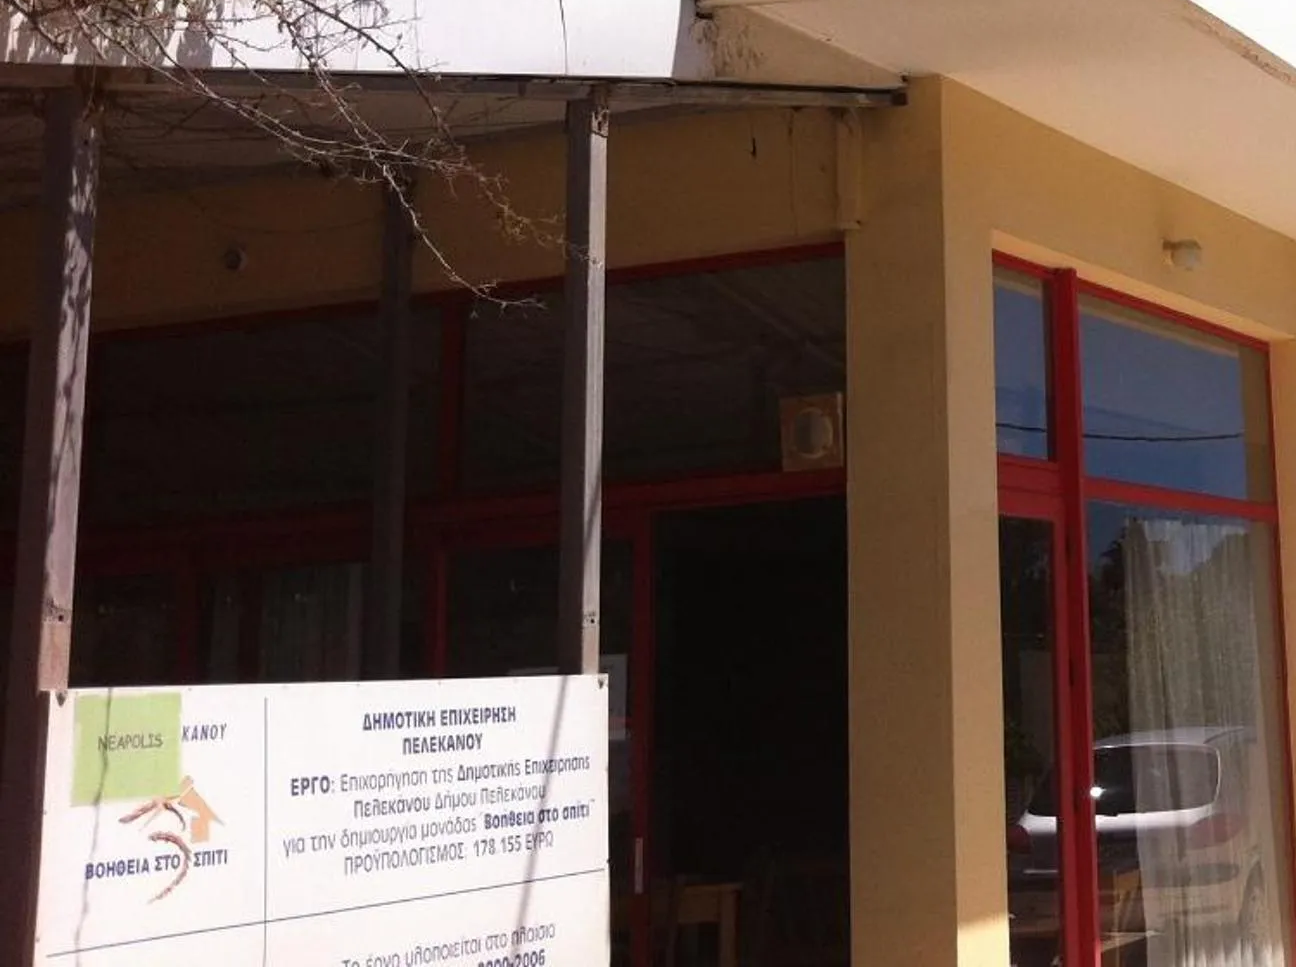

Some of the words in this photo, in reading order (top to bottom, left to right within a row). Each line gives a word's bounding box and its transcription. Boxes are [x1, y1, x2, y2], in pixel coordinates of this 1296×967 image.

[362, 709, 436, 731] ΔΗΜΟΤΙΚΗ
[440, 706, 516, 727] ΕΠΙΧΕΙΡΗΣΗ
[97, 733, 164, 752] NEAPOLIS
[402, 733, 483, 755] ΠΕΛΕΚΑΝΟΥ
[290, 775, 335, 797] ΕΡΓΟ:
[431, 767, 453, 784] της
[457, 761, 521, 782] Δημοτικής
[353, 794, 430, 820] Πελεκάνου
[435, 790, 476, 812] Δήμου
[480, 783, 546, 805] Πελεκάνου
[283, 837, 305, 858] για
[310, 832, 336, 852] την
[421, 816, 476, 842] μονάδας
[538, 806, 559, 824] στο
[473, 838, 496, 857] 178
[501, 835, 522, 853] 155
[525, 830, 554, 850] ΕΥΡΩ
[85, 858, 150, 880] ΒΟΗΘΕΙΑ
[154, 854, 181, 871] ΣΤΟ
[193, 849, 228, 868] ΣΠΙΤΙ
[405, 937, 481, 967] υλοποιείται
[485, 933, 507, 951] στο
